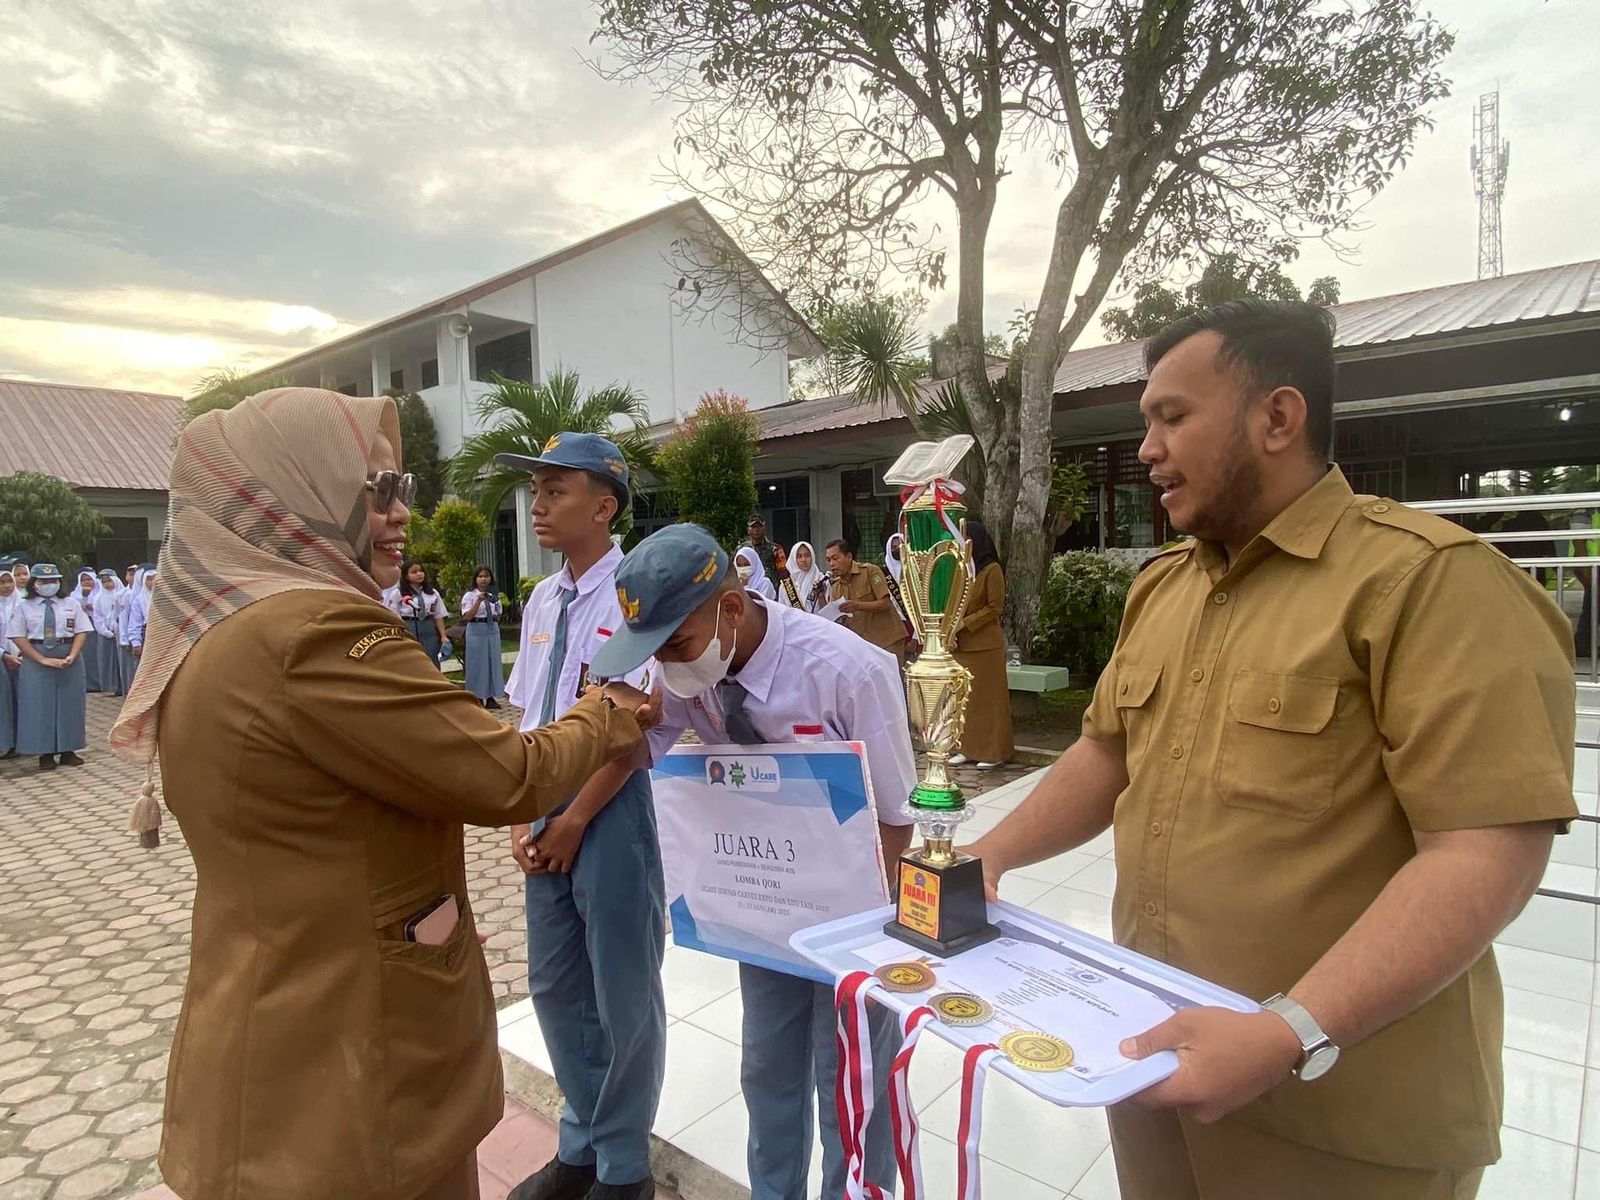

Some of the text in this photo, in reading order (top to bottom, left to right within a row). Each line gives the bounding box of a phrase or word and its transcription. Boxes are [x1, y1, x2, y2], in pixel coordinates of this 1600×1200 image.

[714, 833, 796, 862] JUARA 3
[735, 875, 781, 889] LOMBA QORI
[903, 883, 926, 903] JUARA
[927, 892, 936, 907] III
